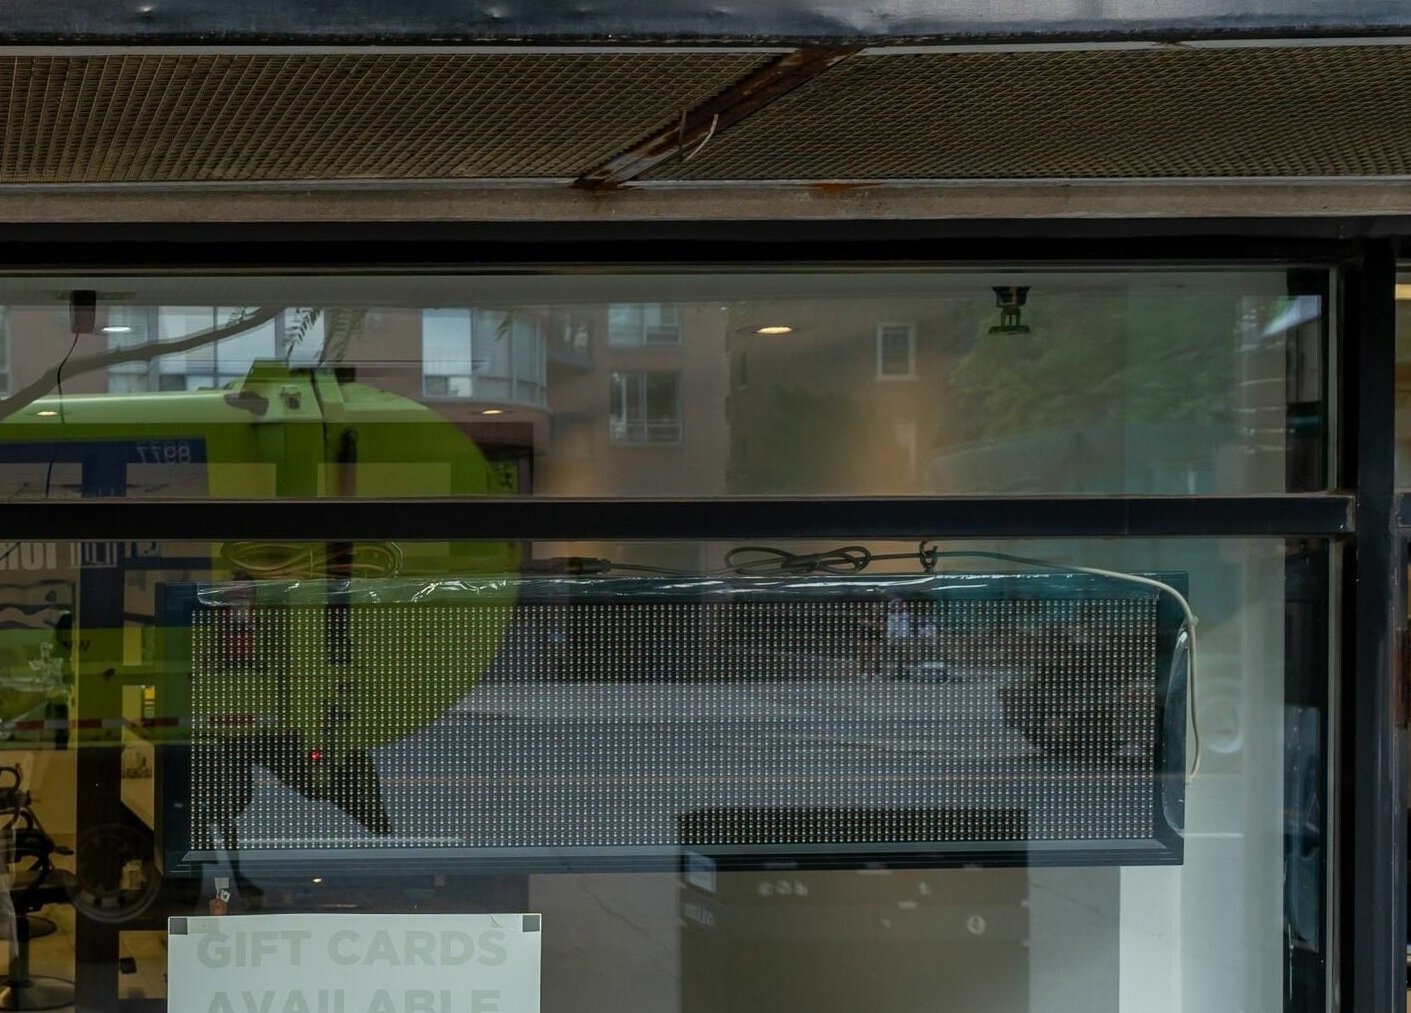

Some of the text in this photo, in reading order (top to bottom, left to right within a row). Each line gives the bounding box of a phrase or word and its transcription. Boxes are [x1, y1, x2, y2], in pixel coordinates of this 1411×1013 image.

[196, 929, 508, 968] GIFT CARDS
[208, 989, 501, 1013] AVAILABLE
